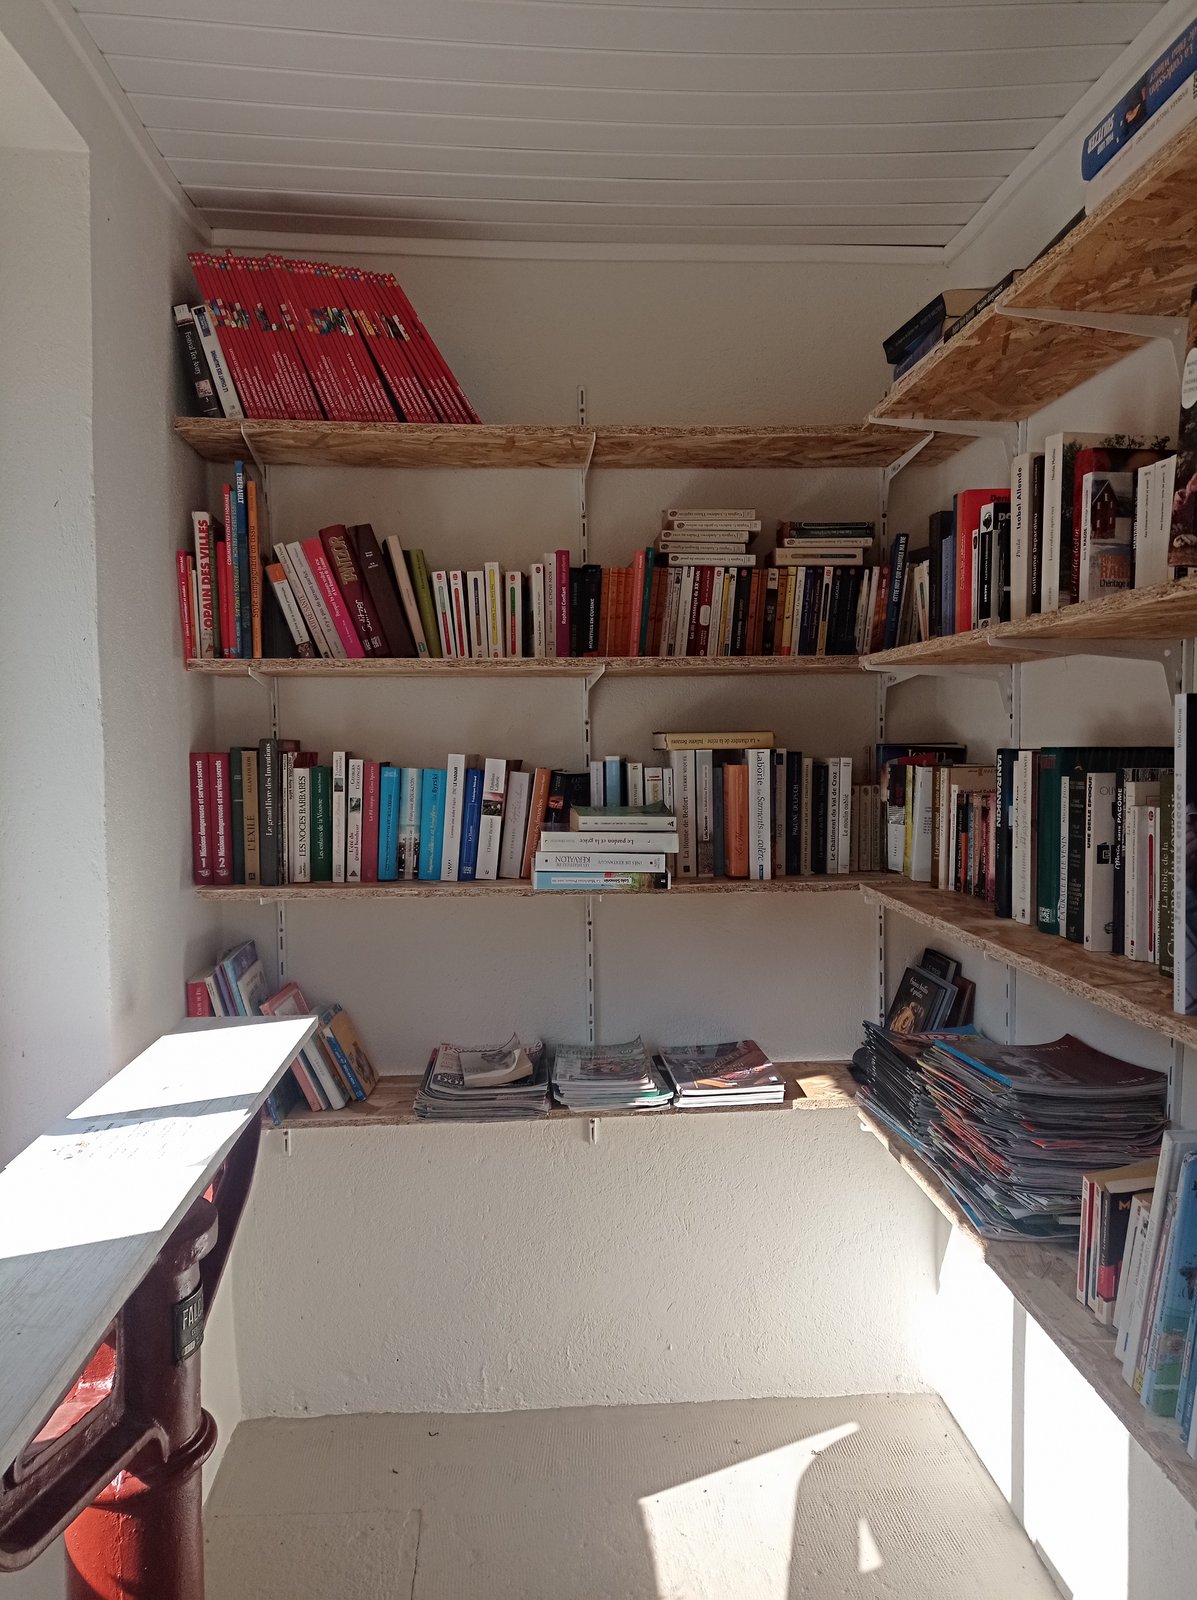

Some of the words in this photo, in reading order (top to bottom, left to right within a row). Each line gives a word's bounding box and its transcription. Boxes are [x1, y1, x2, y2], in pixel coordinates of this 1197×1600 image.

[197, 520, 210, 559] VILLES
[250, 545, 256, 553] en
[896, 551, 904, 571] CHANGEA
[199, 563, 211, 585] DES
[249, 555, 259, 598] campagnard
[201, 586, 213, 631] OPAIN
[355, 599, 373, 632] Sulitzer
[757, 751, 765, 786] Laborie
[298, 776, 306, 814] BARBARES
[831, 788, 837, 796] de
[265, 806, 274, 826] grand
[757, 796, 765, 829] Sarments
[830, 809, 836, 817] du
[1115, 788, 1123, 824] PACÔME
[199, 805, 207, 835] dangereuses
[217, 804, 225, 835] dangereuses
[683, 820, 688, 828] de
[245, 815, 256, 851] L'EXILÉ
[265, 826, 272, 836] Le
[199, 836, 207, 857] Missions
[683, 850, 689, 859] La
[757, 839, 765, 861] colère
[830, 853, 836, 861] Le
[1113, 844, 1122, 870] Maria
[1161, 842, 1168, 852] la
[219, 857, 225, 868] 2
[555, 856, 591, 864] KERVALON
[1161, 854, 1168, 870] de
[1161, 894, 1168, 909] La
